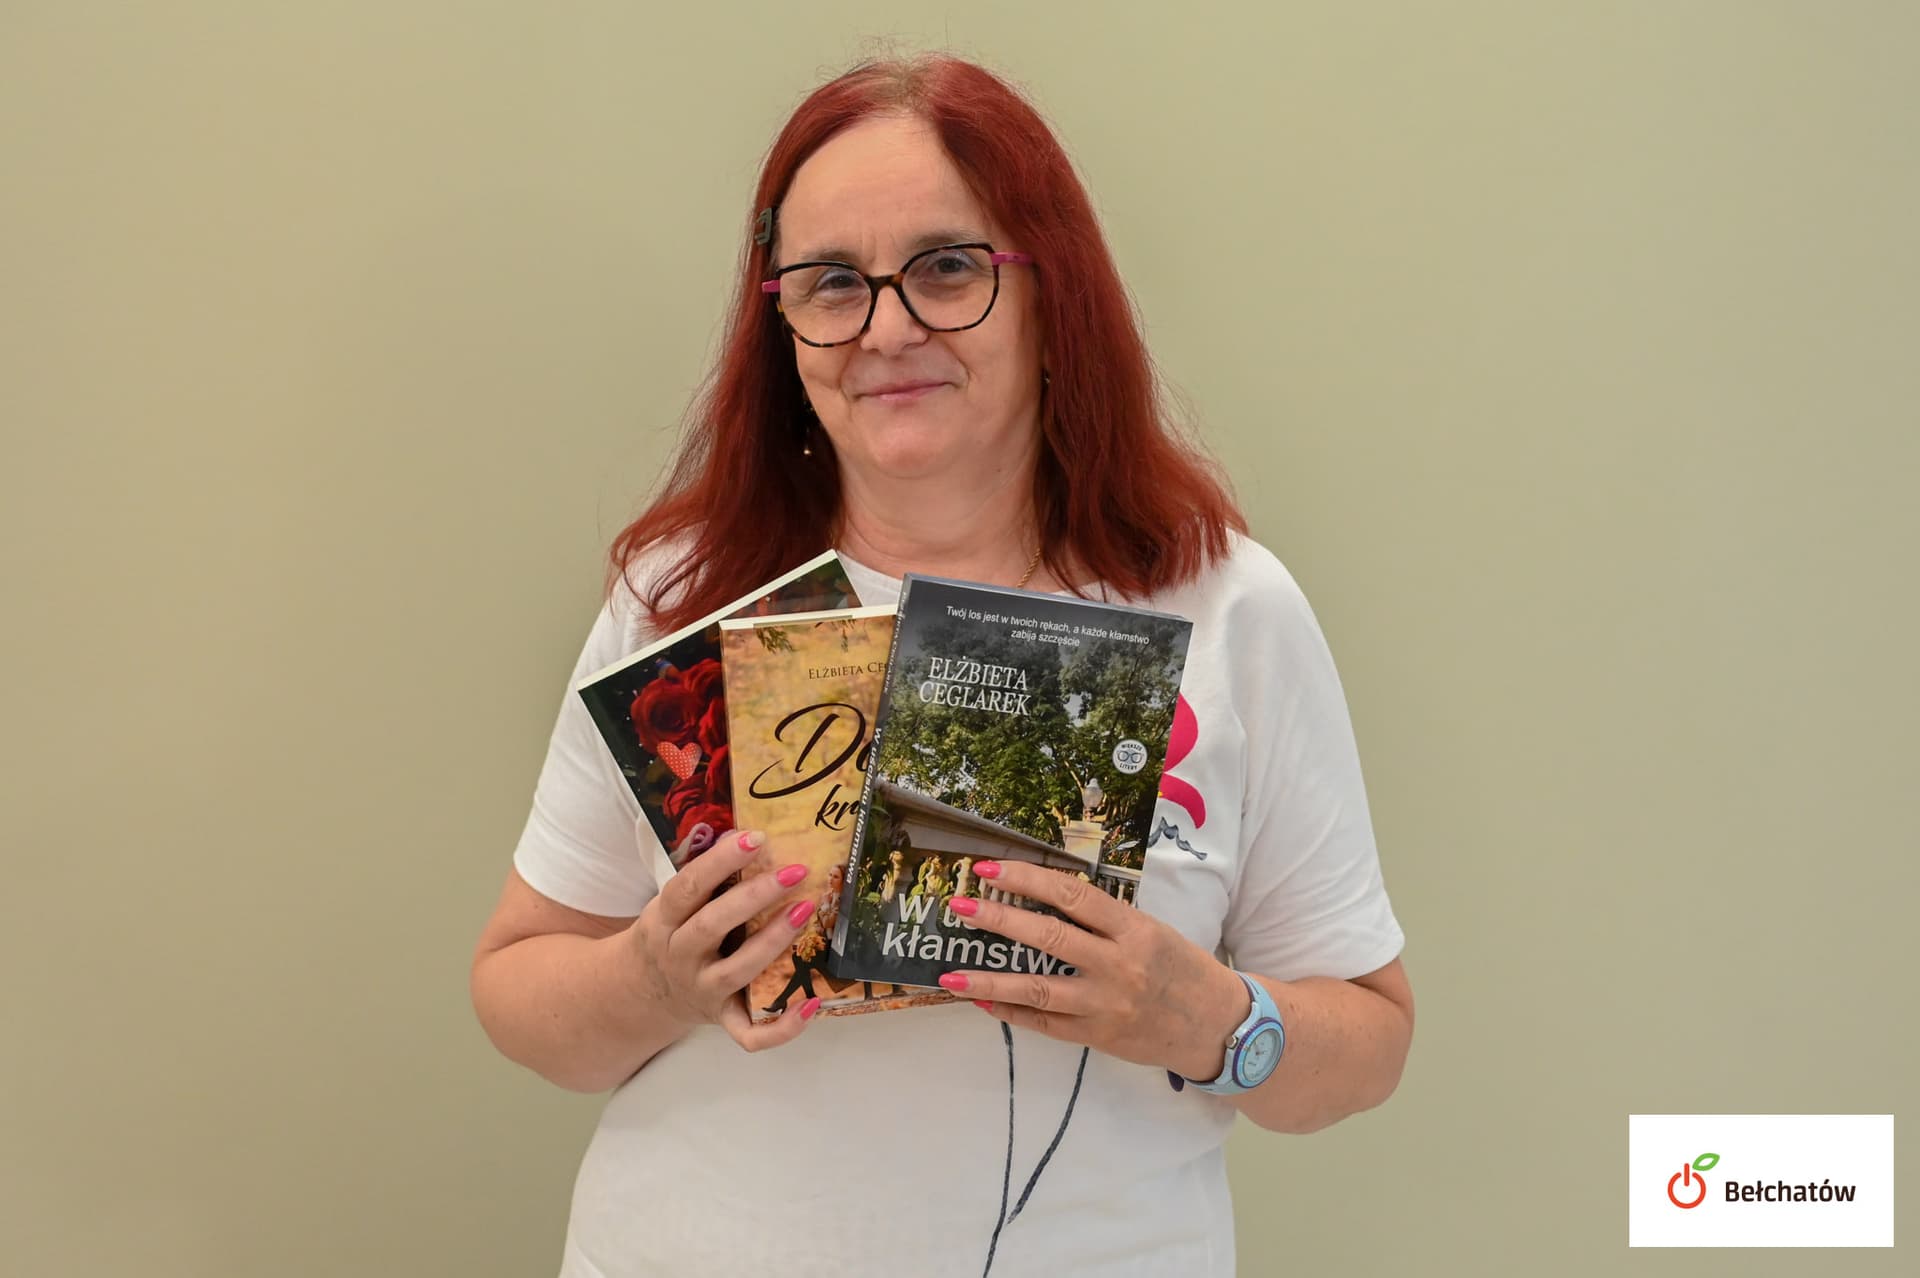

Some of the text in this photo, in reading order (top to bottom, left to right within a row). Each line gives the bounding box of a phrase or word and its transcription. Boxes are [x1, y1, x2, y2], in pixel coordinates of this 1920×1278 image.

[946, 605, 1150, 645] Twój los jest w twoich rękach, a każde kłamstwo
[1011, 629, 1081, 647] zabija szczęście
[808, 665, 864, 680] ELŻBIETA
[927, 655, 1028, 691] ELŻBIETA
[919, 681, 1032, 716] CEGLAREK
[874, 727, 883, 745] W
[898, 893, 935, 925] W
